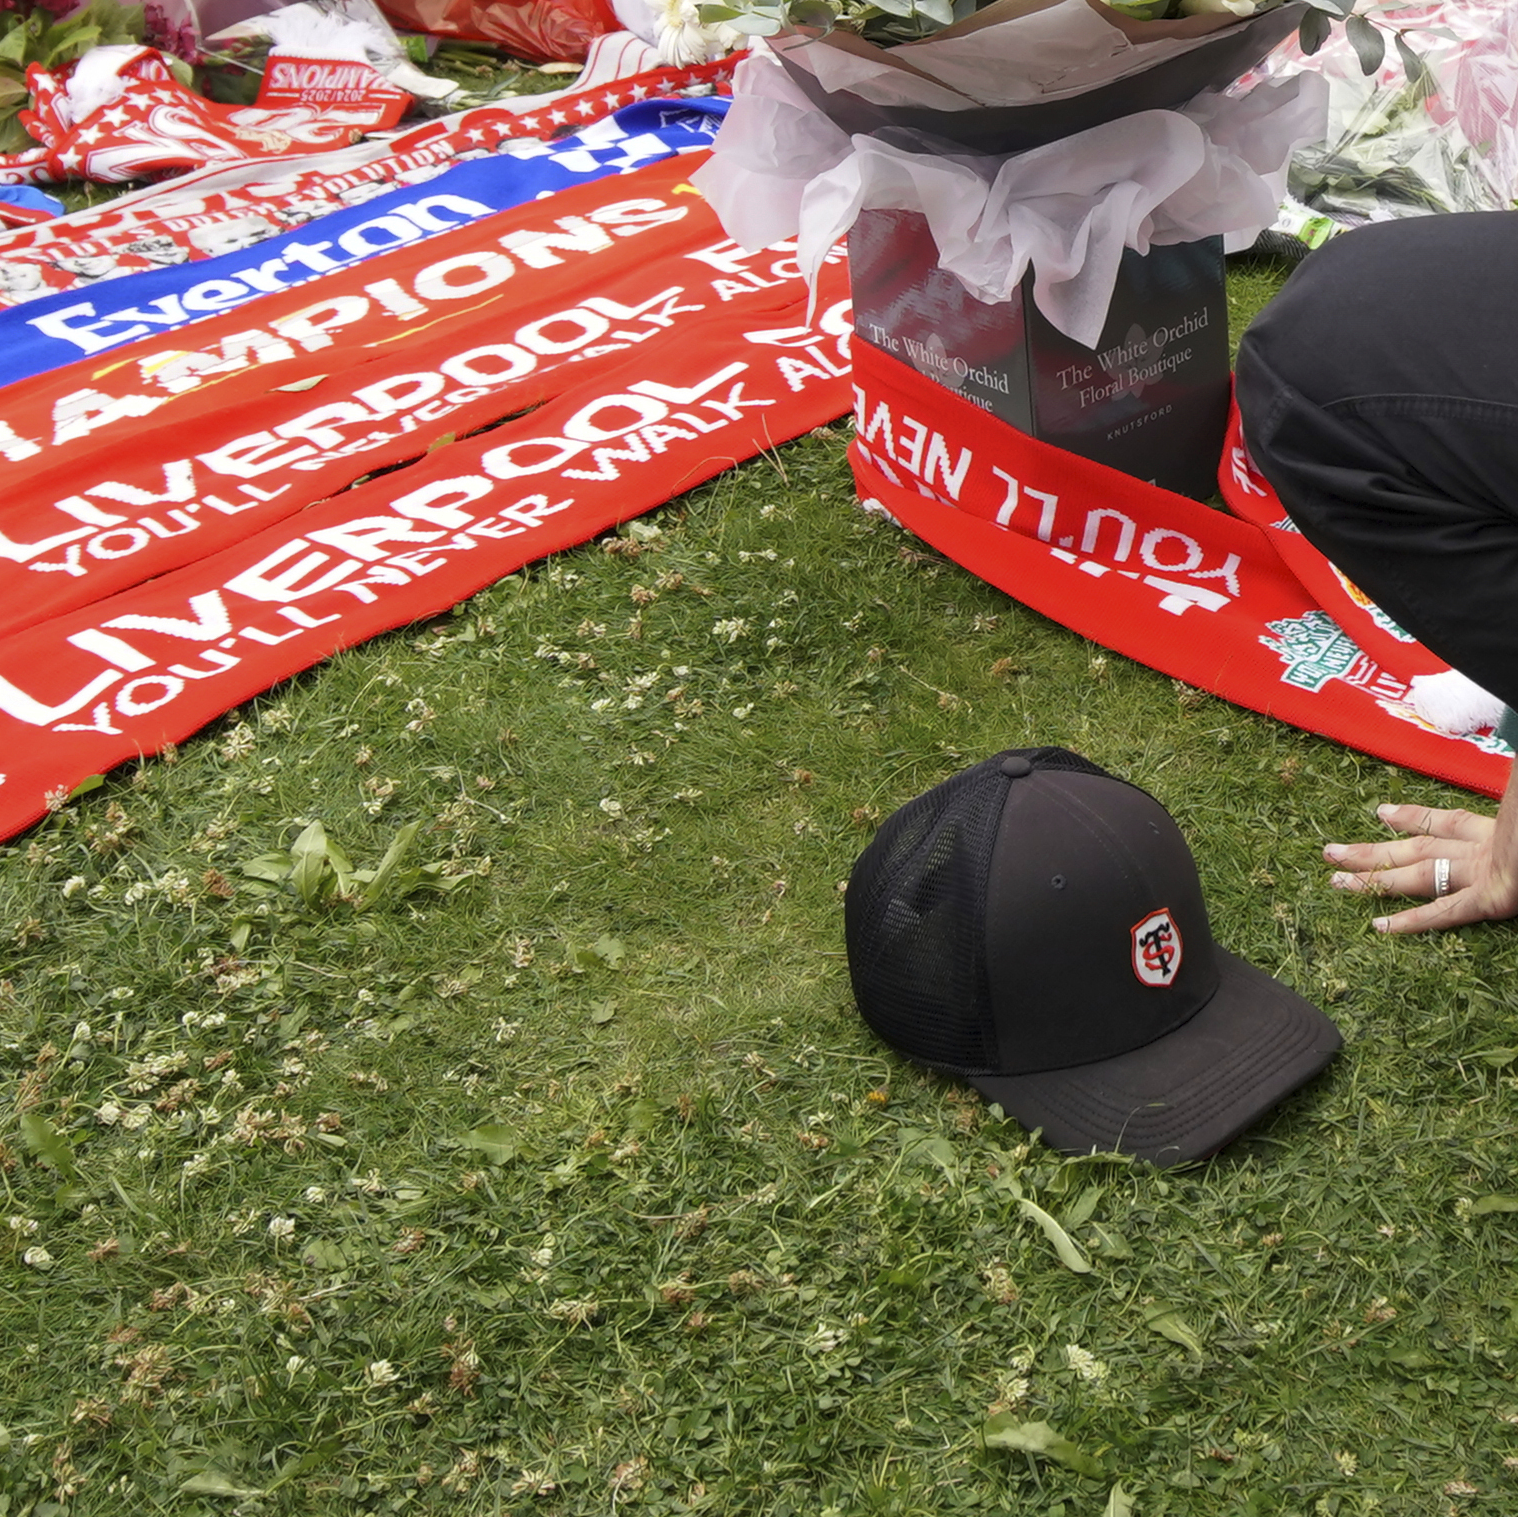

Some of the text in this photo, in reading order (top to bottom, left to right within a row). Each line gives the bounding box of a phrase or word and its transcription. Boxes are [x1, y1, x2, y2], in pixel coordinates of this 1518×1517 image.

[300, 88, 366, 103] 2024/2025
[24, 192, 499, 356] Everton
[869, 323, 1011, 396] The White Orchid
[1055, 307, 1210, 392] The White Orchid
[1079, 346, 1194, 409] Floral Boutique
[1106, 404, 1174, 442] KNUTSFORD
[29, 480, 292, 578] YOU'LL
[51, 606, 342, 736] YOU'LL
[341, 492, 576, 604] NEVER
[560, 381, 777, 482] WALK
[992, 464, 1242, 598] YOU'LL
